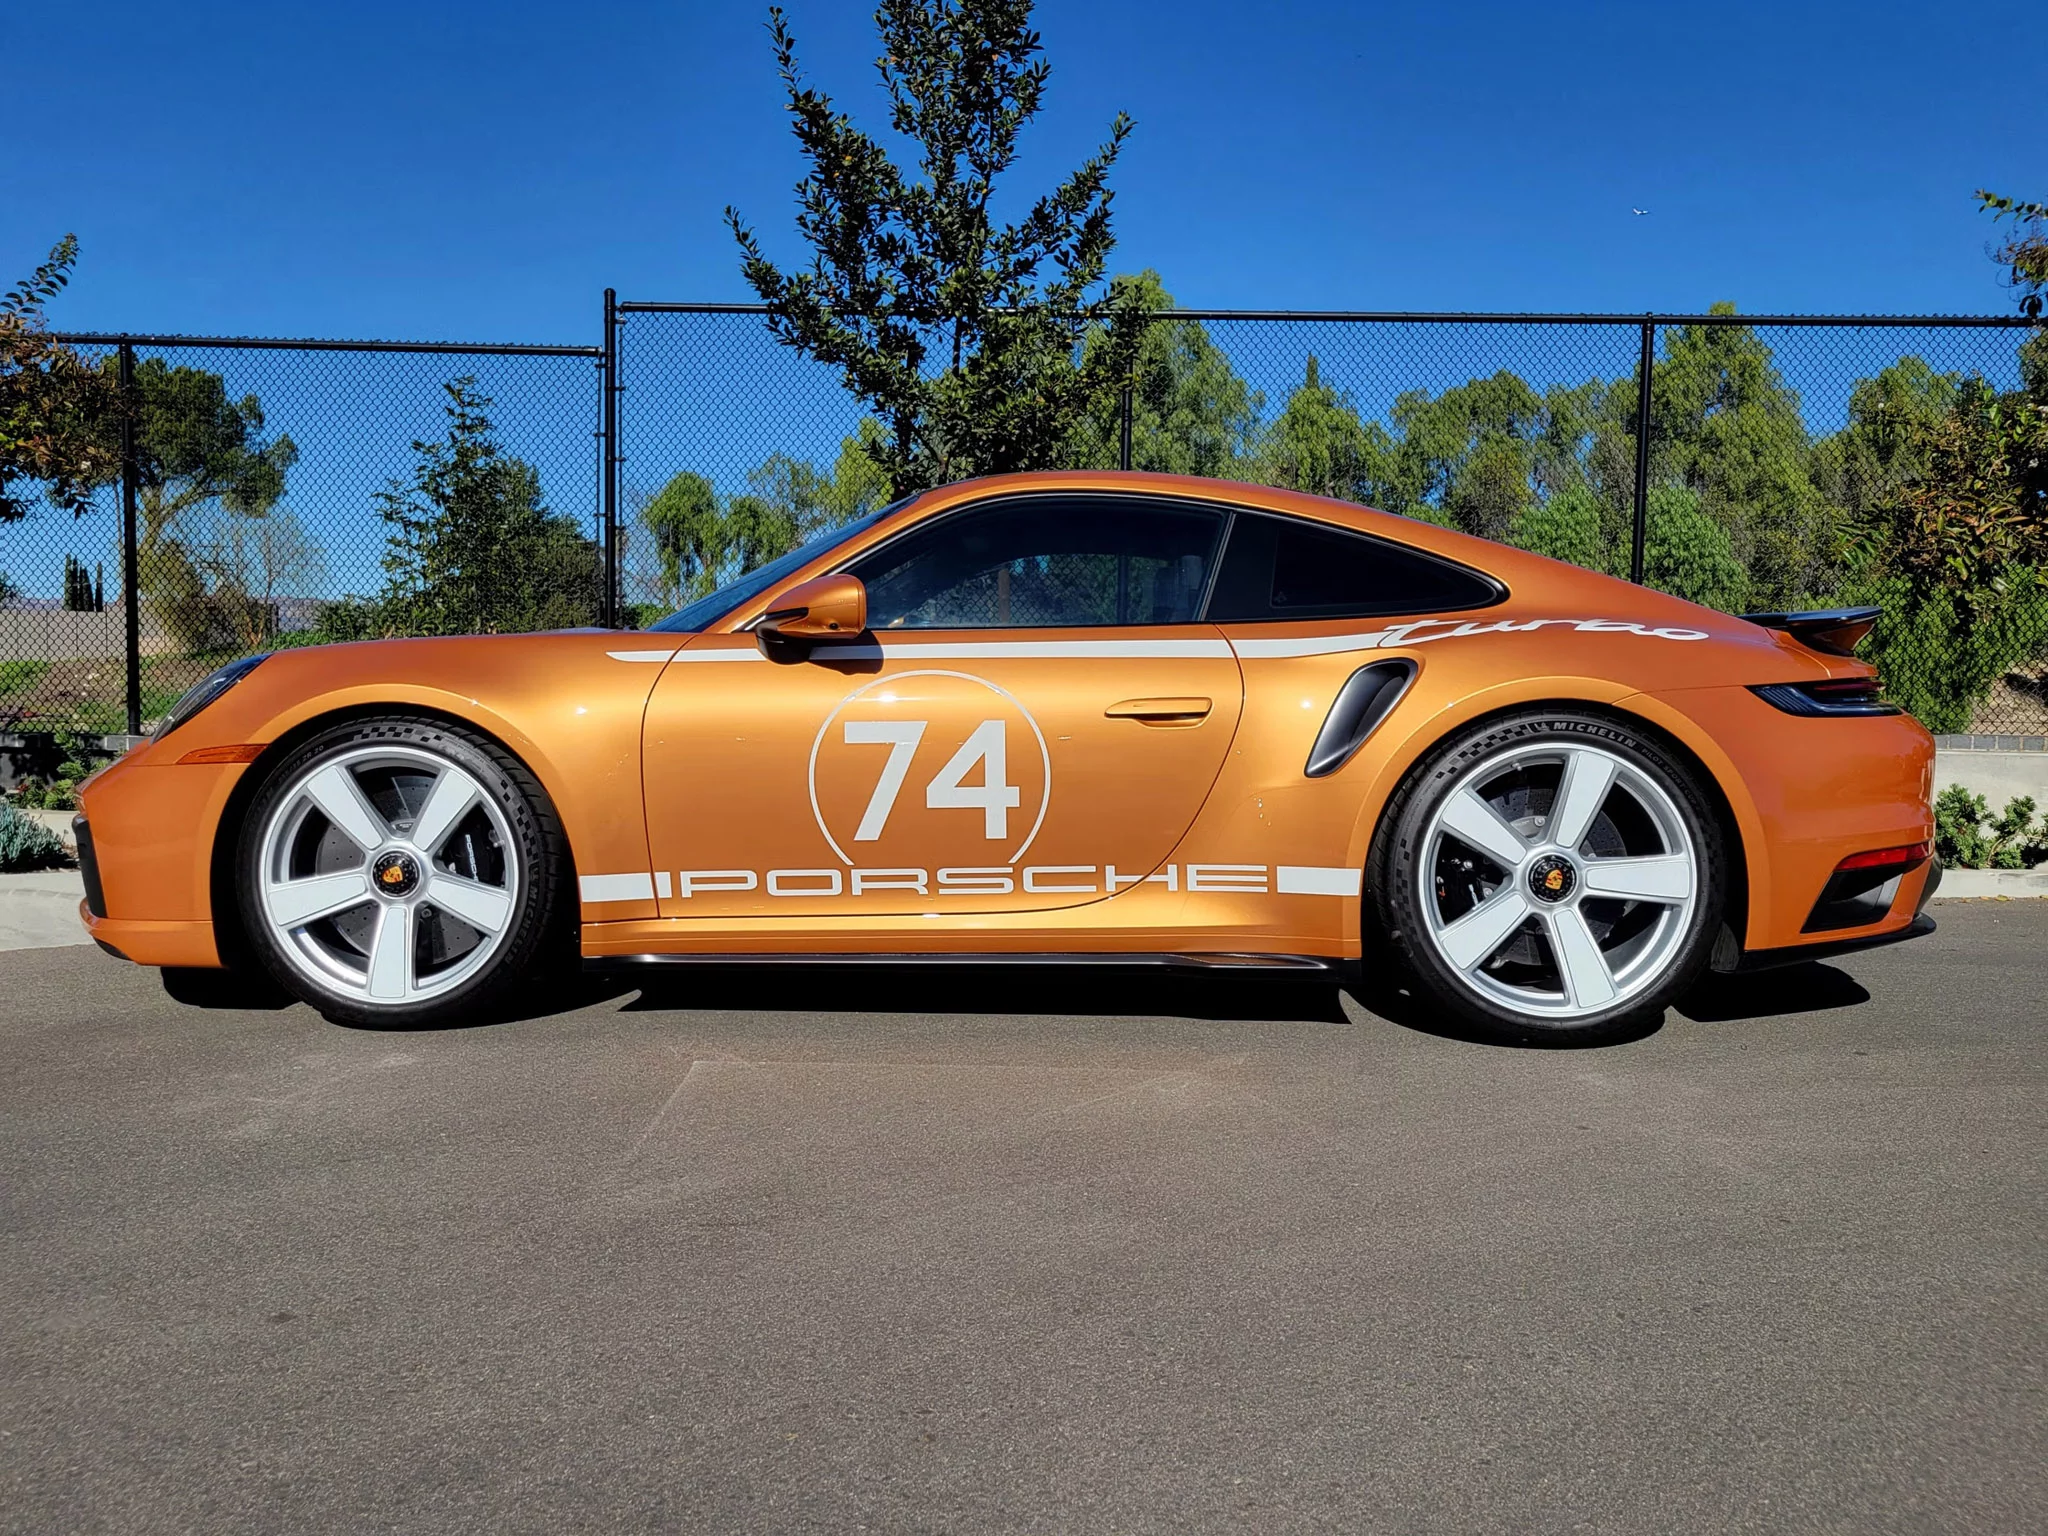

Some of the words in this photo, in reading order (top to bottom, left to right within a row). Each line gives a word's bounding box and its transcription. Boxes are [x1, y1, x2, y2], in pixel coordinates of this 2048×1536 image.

[1380, 619, 1710, 648] turbo
[844, 719, 1020, 841] 74
[1553, 721, 1637, 748] MICHELIN
[1641, 747, 1664, 767] PILOT
[1663, 764, 1686, 789] SPORT
[465, 834, 480, 882] PORSCH
[680, 864, 1268, 898] PORSCHE
[504, 884, 538, 965] MICHELIN
